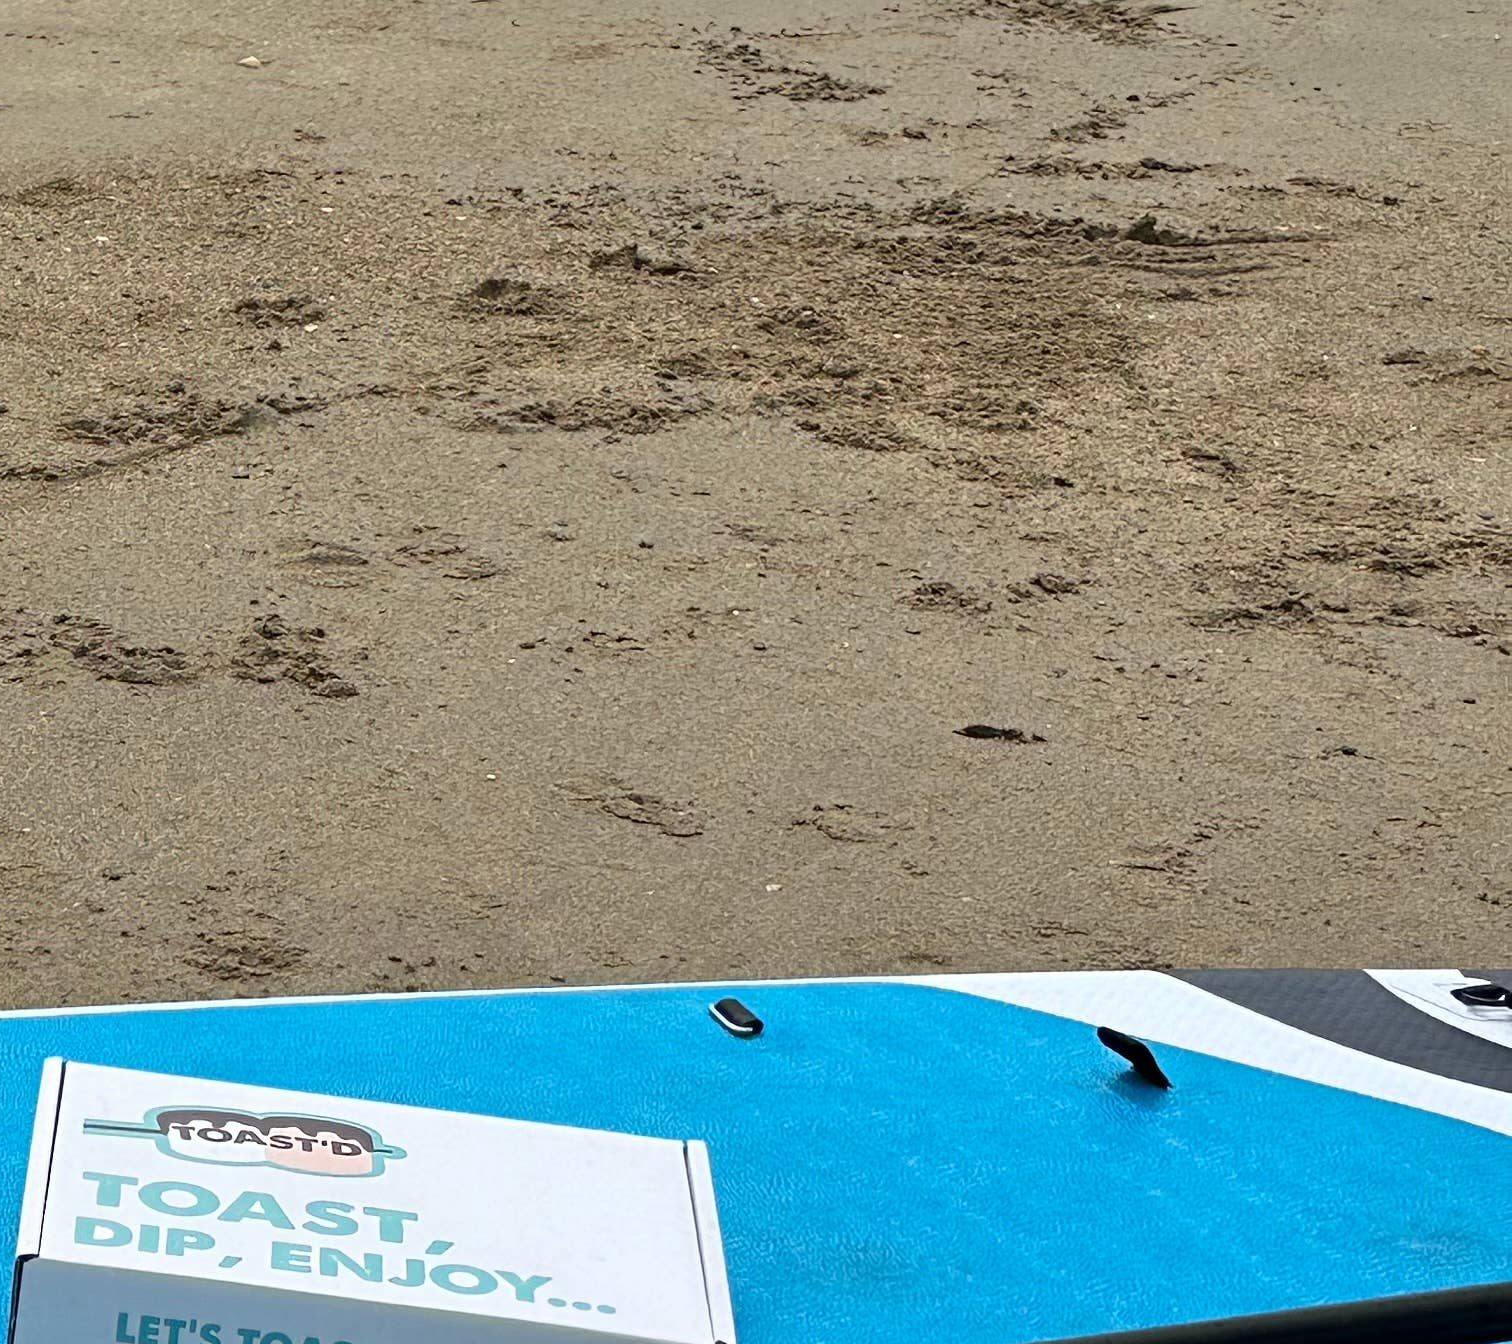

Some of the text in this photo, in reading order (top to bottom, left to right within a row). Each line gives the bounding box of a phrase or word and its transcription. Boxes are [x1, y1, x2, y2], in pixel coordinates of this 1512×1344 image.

[172, 1125, 363, 1156] TOAST'D
[82, 1171, 455, 1255] TOAST,
[74, 1216, 616, 1314] DIP, ENJOY...
